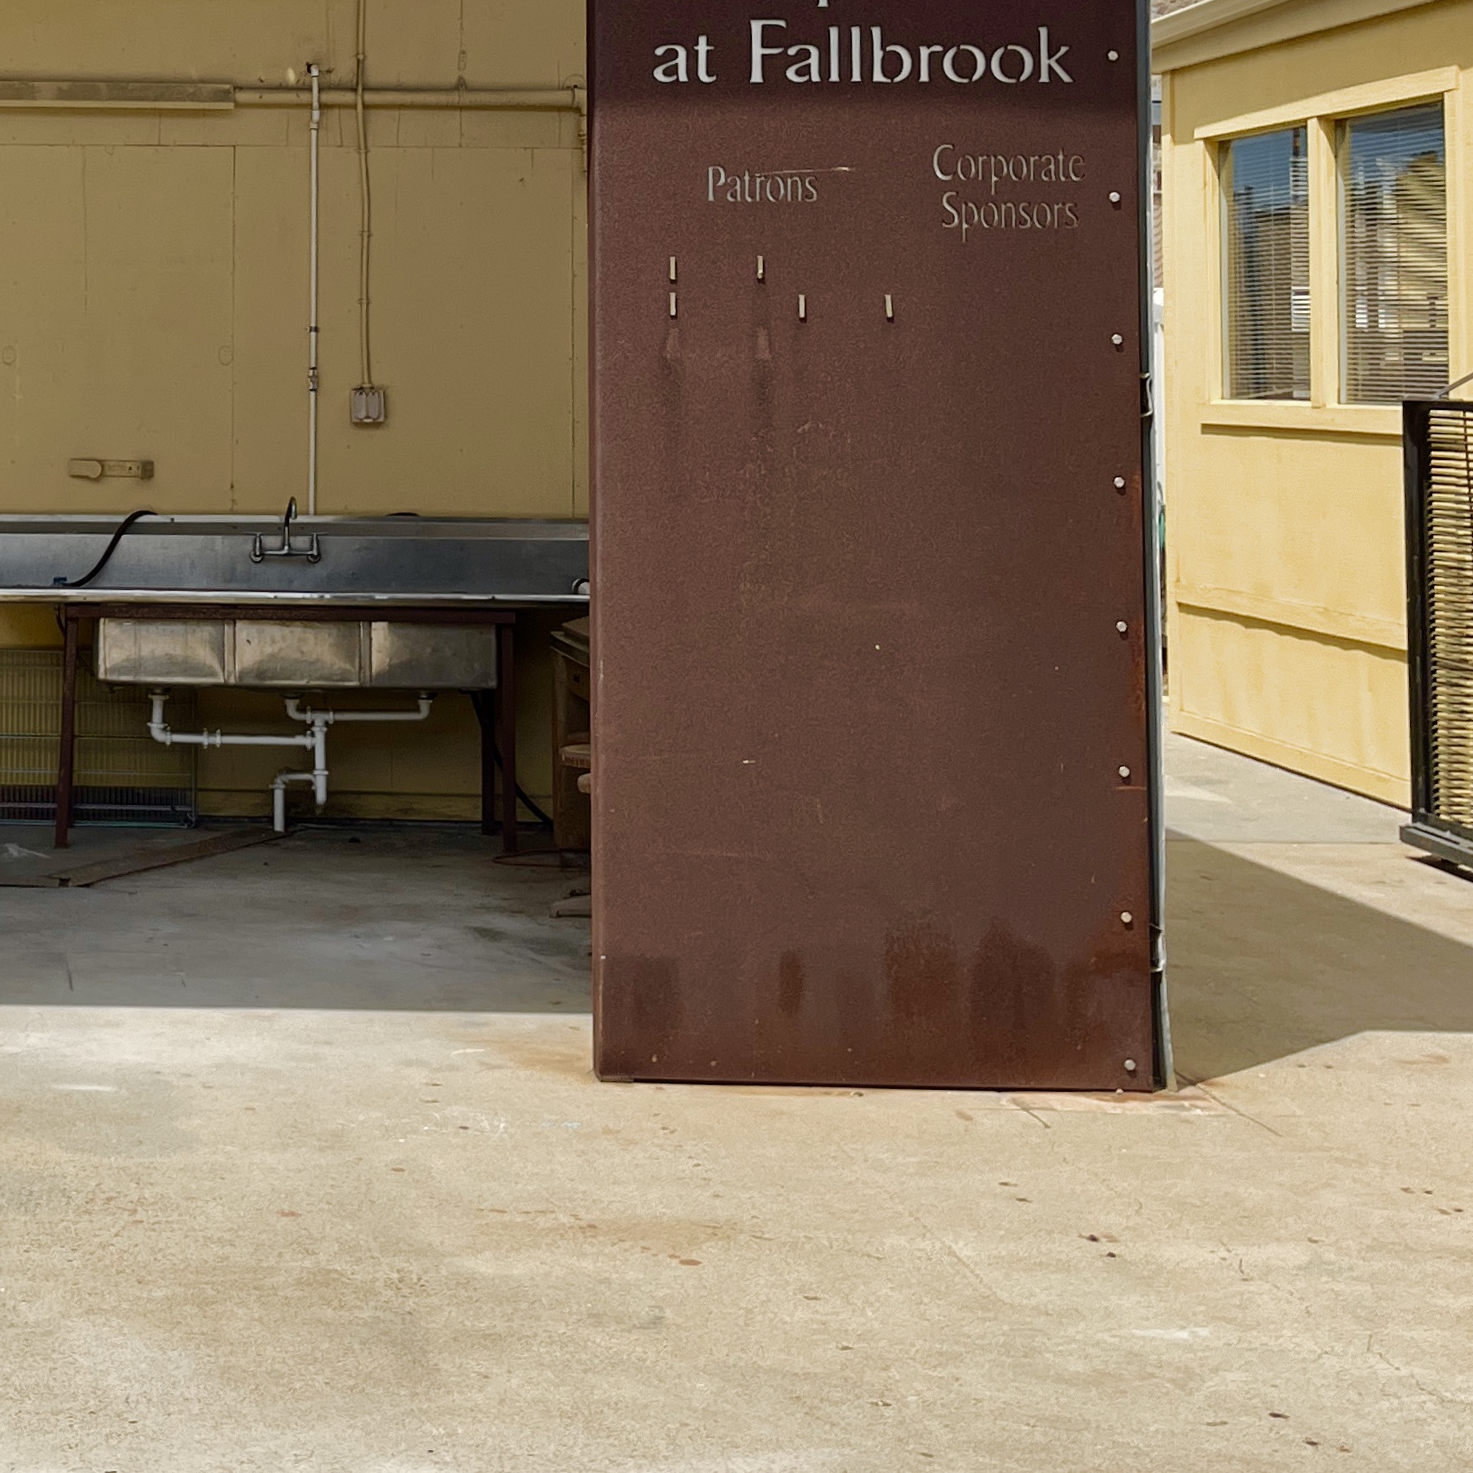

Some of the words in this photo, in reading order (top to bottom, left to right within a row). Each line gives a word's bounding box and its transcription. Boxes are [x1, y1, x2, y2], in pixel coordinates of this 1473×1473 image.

[652, 35, 717, 83] at
[749, 19, 1076, 83] Fallbrook
[707, 165, 819, 203] Patrons
[932, 144, 1086, 195] Corporate
[942, 192, 1080, 242] Sponsors
